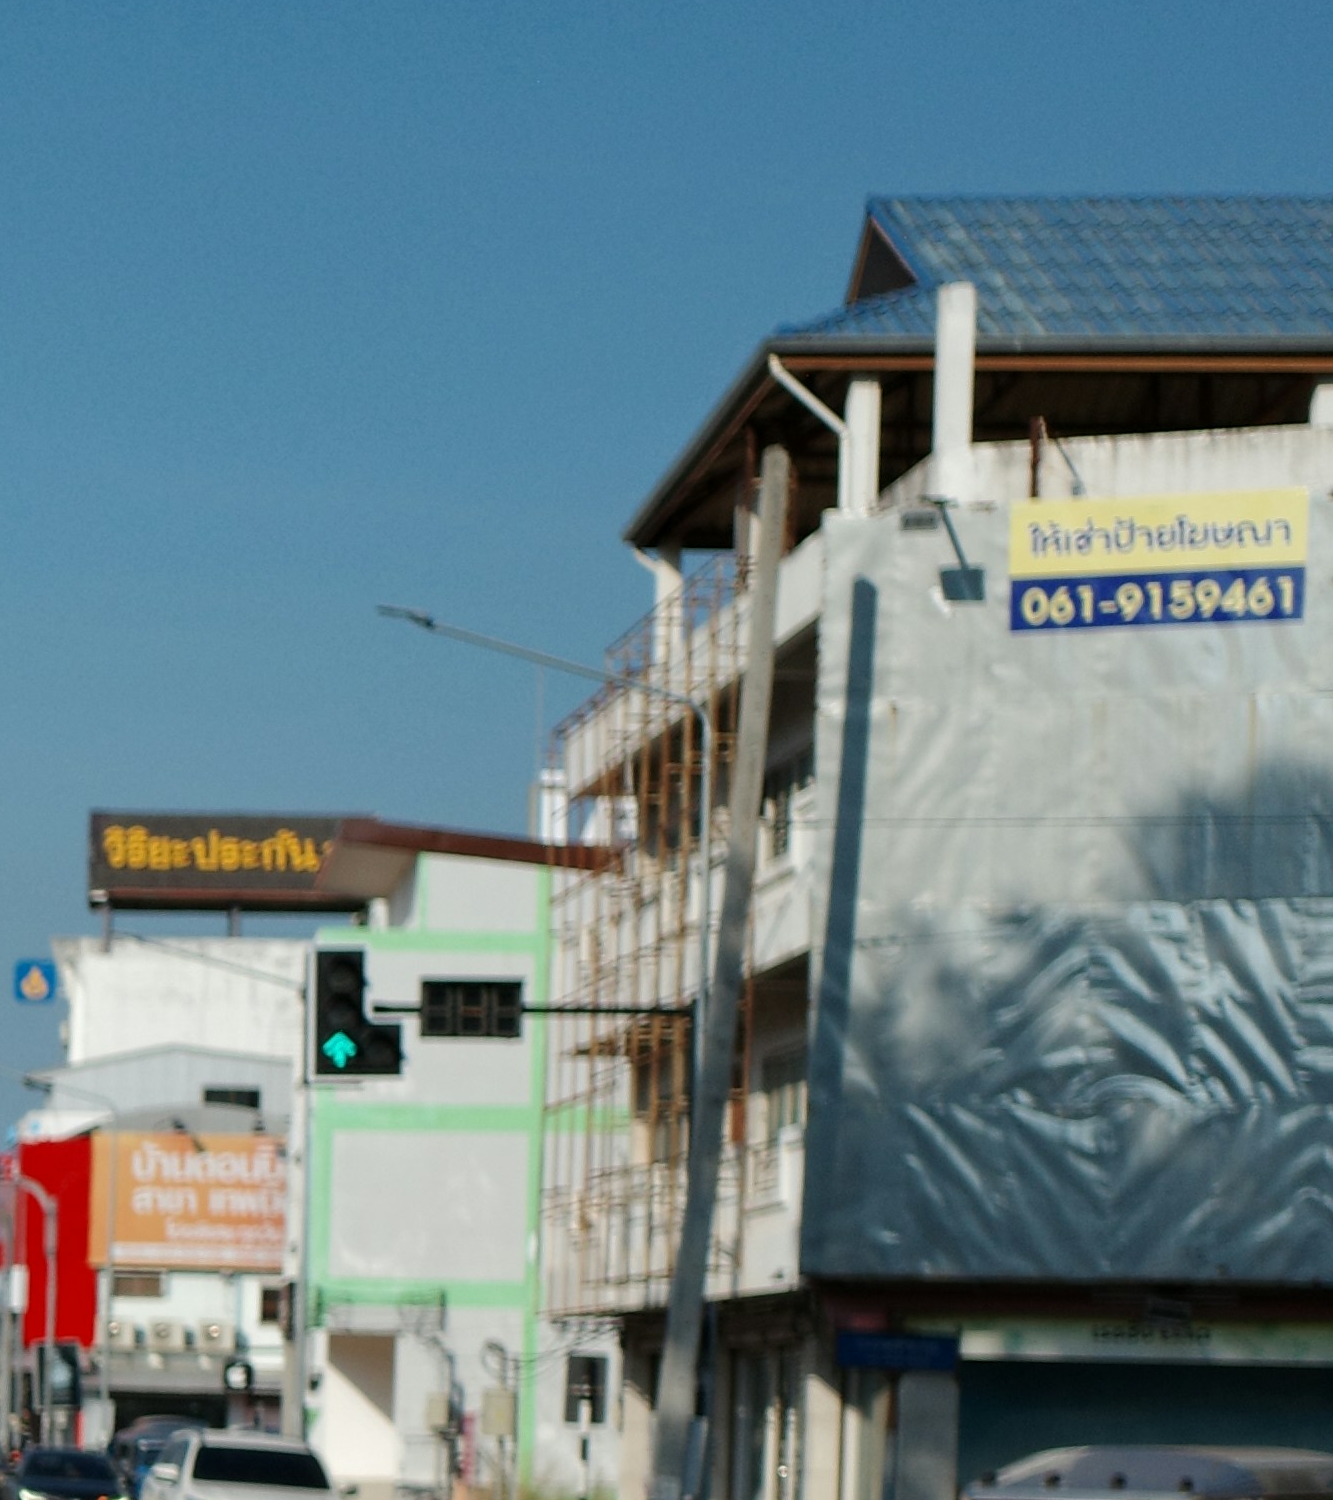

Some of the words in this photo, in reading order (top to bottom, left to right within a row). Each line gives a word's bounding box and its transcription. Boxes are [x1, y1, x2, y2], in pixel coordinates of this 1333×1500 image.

[1028, 514, 1291, 558] ให้เช่าป้ายโฆษณา
[1021, 575, 1295, 627] 061-9159461
[102, 824, 331, 873] วิริยะประกัน
